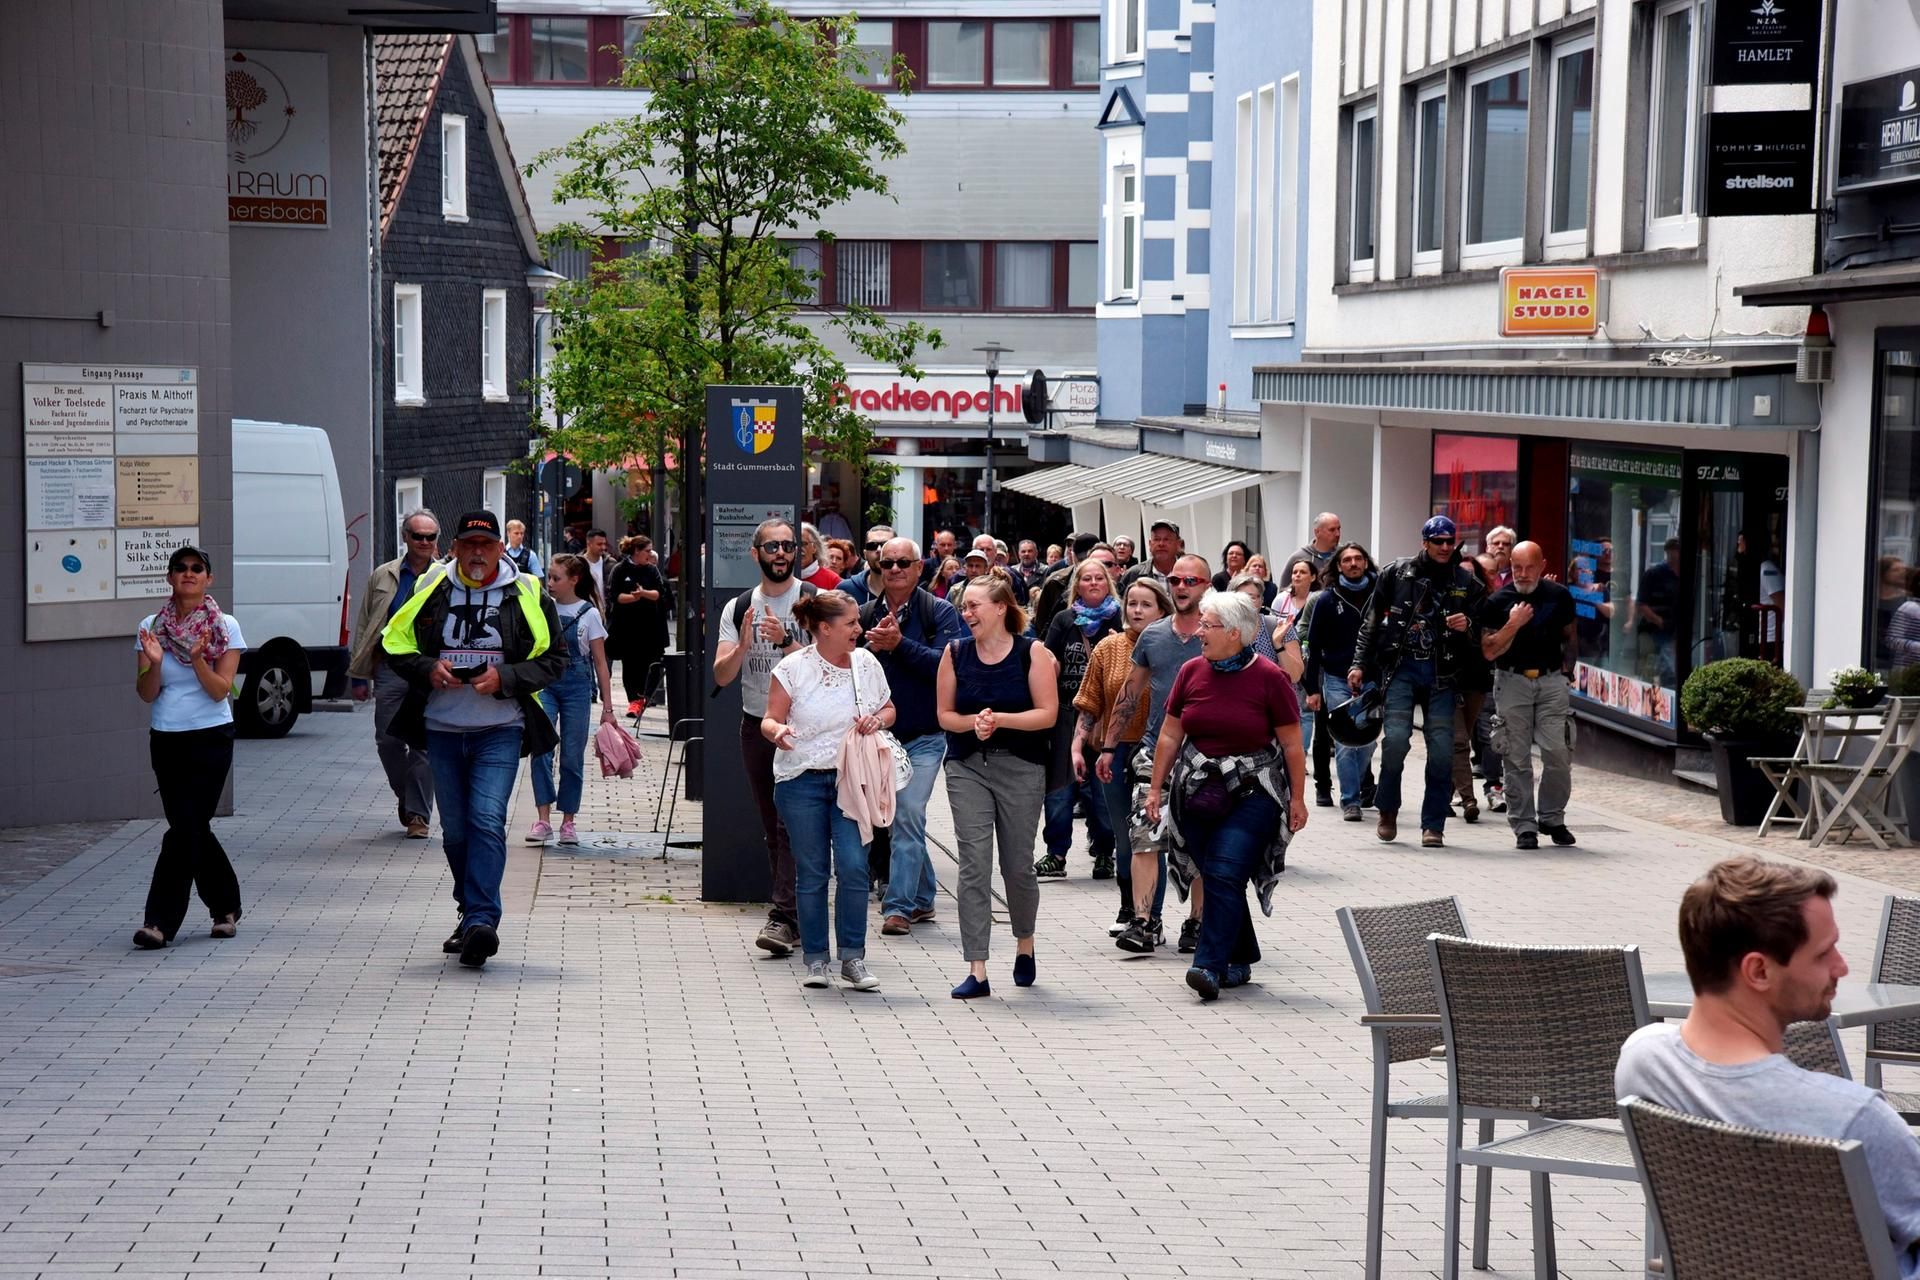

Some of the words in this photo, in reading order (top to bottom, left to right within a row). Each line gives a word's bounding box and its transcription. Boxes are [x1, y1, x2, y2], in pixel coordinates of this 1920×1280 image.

[1738, 48, 1793, 62] HAMLET
[1881, 121, 1901, 148] HERR
[1765, 144, 1806, 152] HILFIGER
[238, 171, 327, 197] RAUM
[1726, 174, 1794, 190] strellson
[1519, 287, 1587, 300] NAGEL
[1514, 304, 1590, 318] STUDIO
[82, 368, 112, 380] Eingang
[114, 369, 144, 380] Passage
[54, 386, 66, 395] Dr.
[67, 386, 84, 395] med.
[120, 390, 148, 400] Praxis
[152, 390, 162, 400] M.
[164, 390, 193, 400] Althoff
[33, 397, 62, 408] Volker
[64, 398, 106, 408] Toelstede
[120, 406, 147, 414] Facharzt
[150, 406, 158, 414] für
[160, 406, 194, 416] Psychiatrie
[66, 418, 110, 428] Jugendmedizin
[126, 418, 138, 426] und
[140, 418, 188, 428] Psychotherapie
[712, 462, 735, 470] Stadt
[736, 463, 796, 472] Gummersbach
[466, 520, 492, 528] STIHL
[154, 530, 172, 538] med.
[125, 540, 152, 550] Frank
[127, 552, 150, 562] Silke
